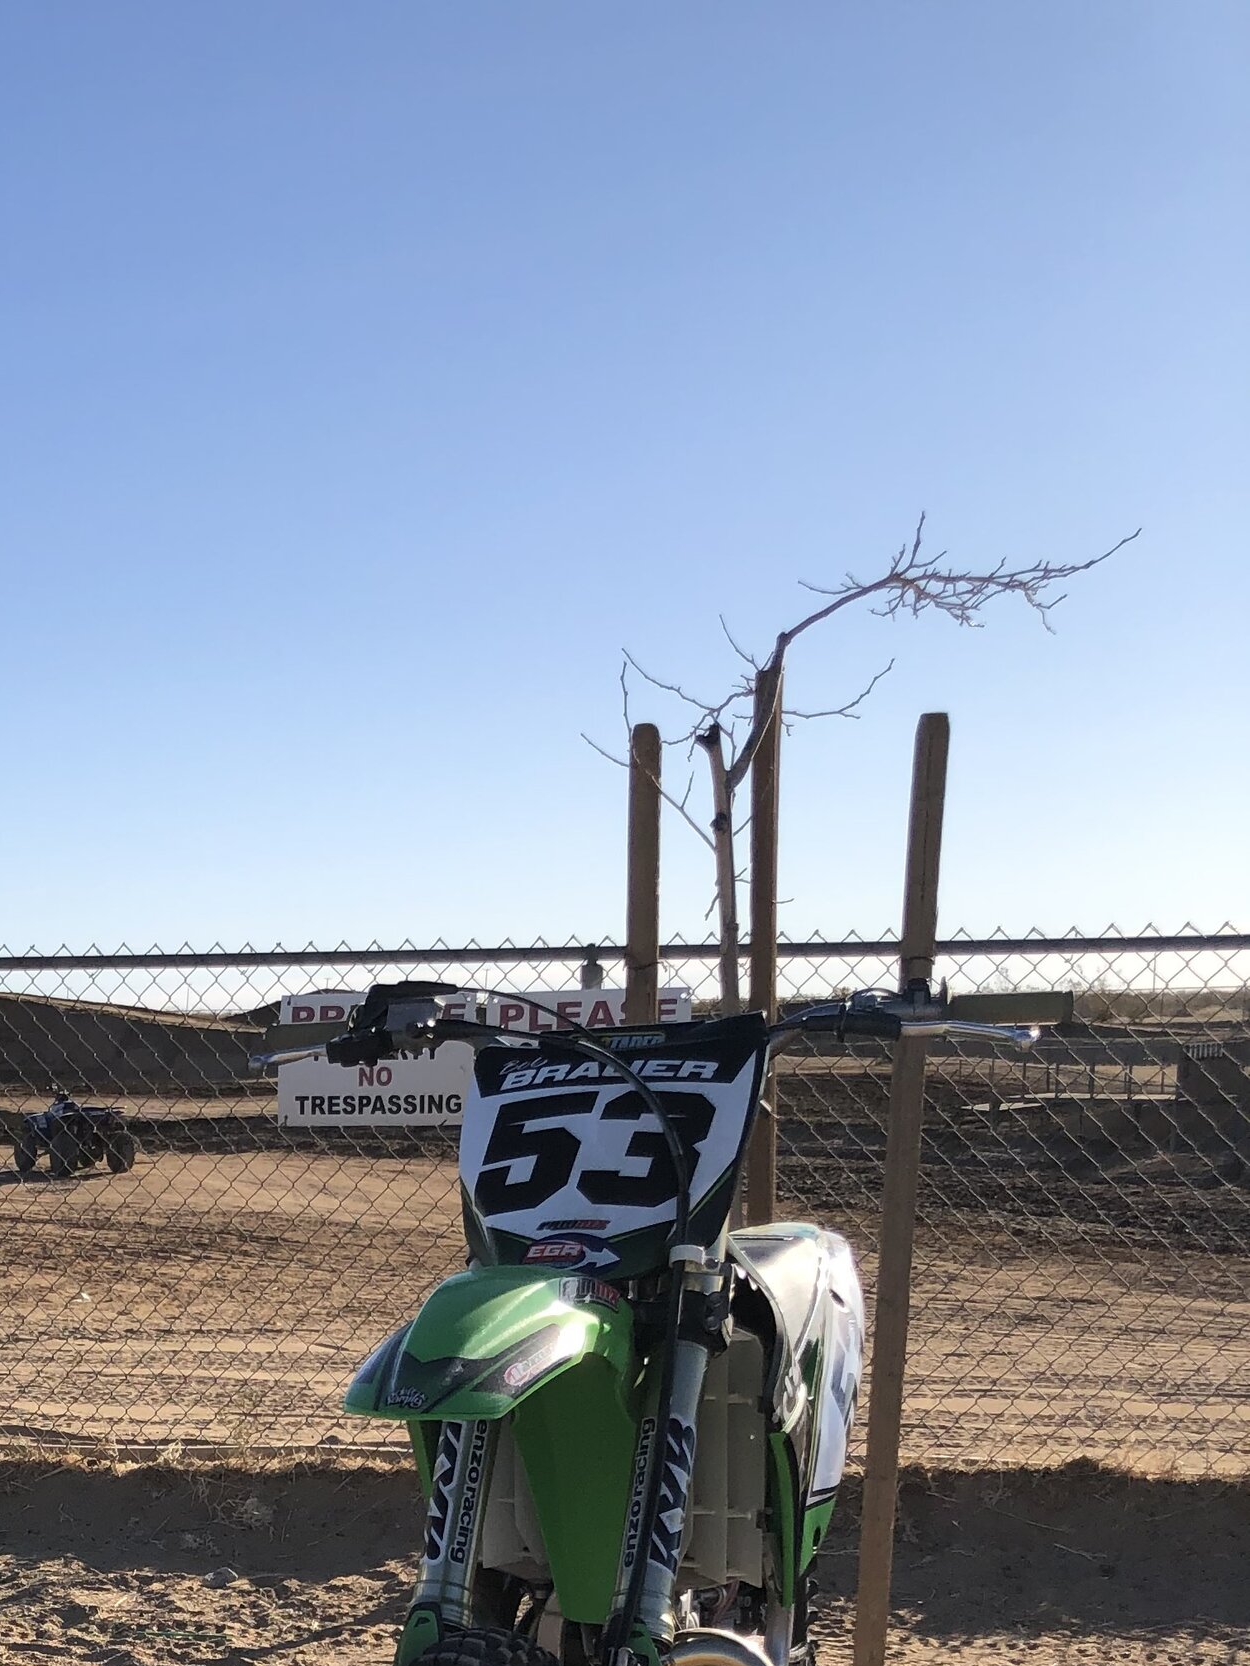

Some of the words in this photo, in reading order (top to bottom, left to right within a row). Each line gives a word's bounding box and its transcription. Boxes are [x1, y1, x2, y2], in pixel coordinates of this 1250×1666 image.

[500, 999, 678, 1031] PLEAE
[357, 1066, 392, 1087] NO
[500, 1059, 719, 1090] BRAUER
[294, 1094, 462, 1115] TRESPASSING
[475, 1090, 717, 1216] 53
